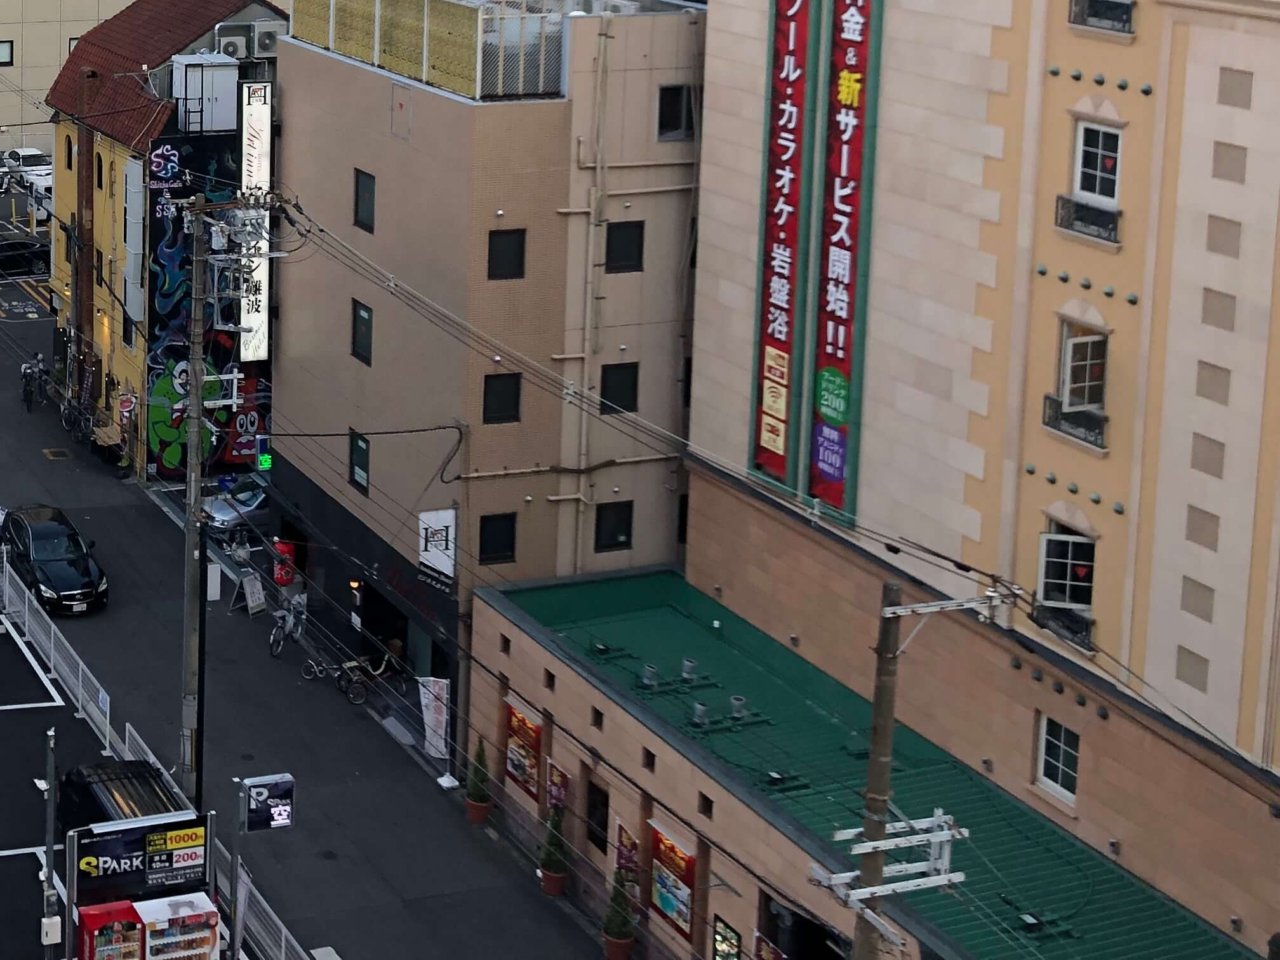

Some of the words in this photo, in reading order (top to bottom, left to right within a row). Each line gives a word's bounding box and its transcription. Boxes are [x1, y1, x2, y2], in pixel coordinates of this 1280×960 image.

[820, 392, 846, 411] 200
[818, 450, 842, 469] 100
[250, 787, 269, 809] P
[270, 805, 291, 828] 空
[80, 856, 144, 877] SPARK
